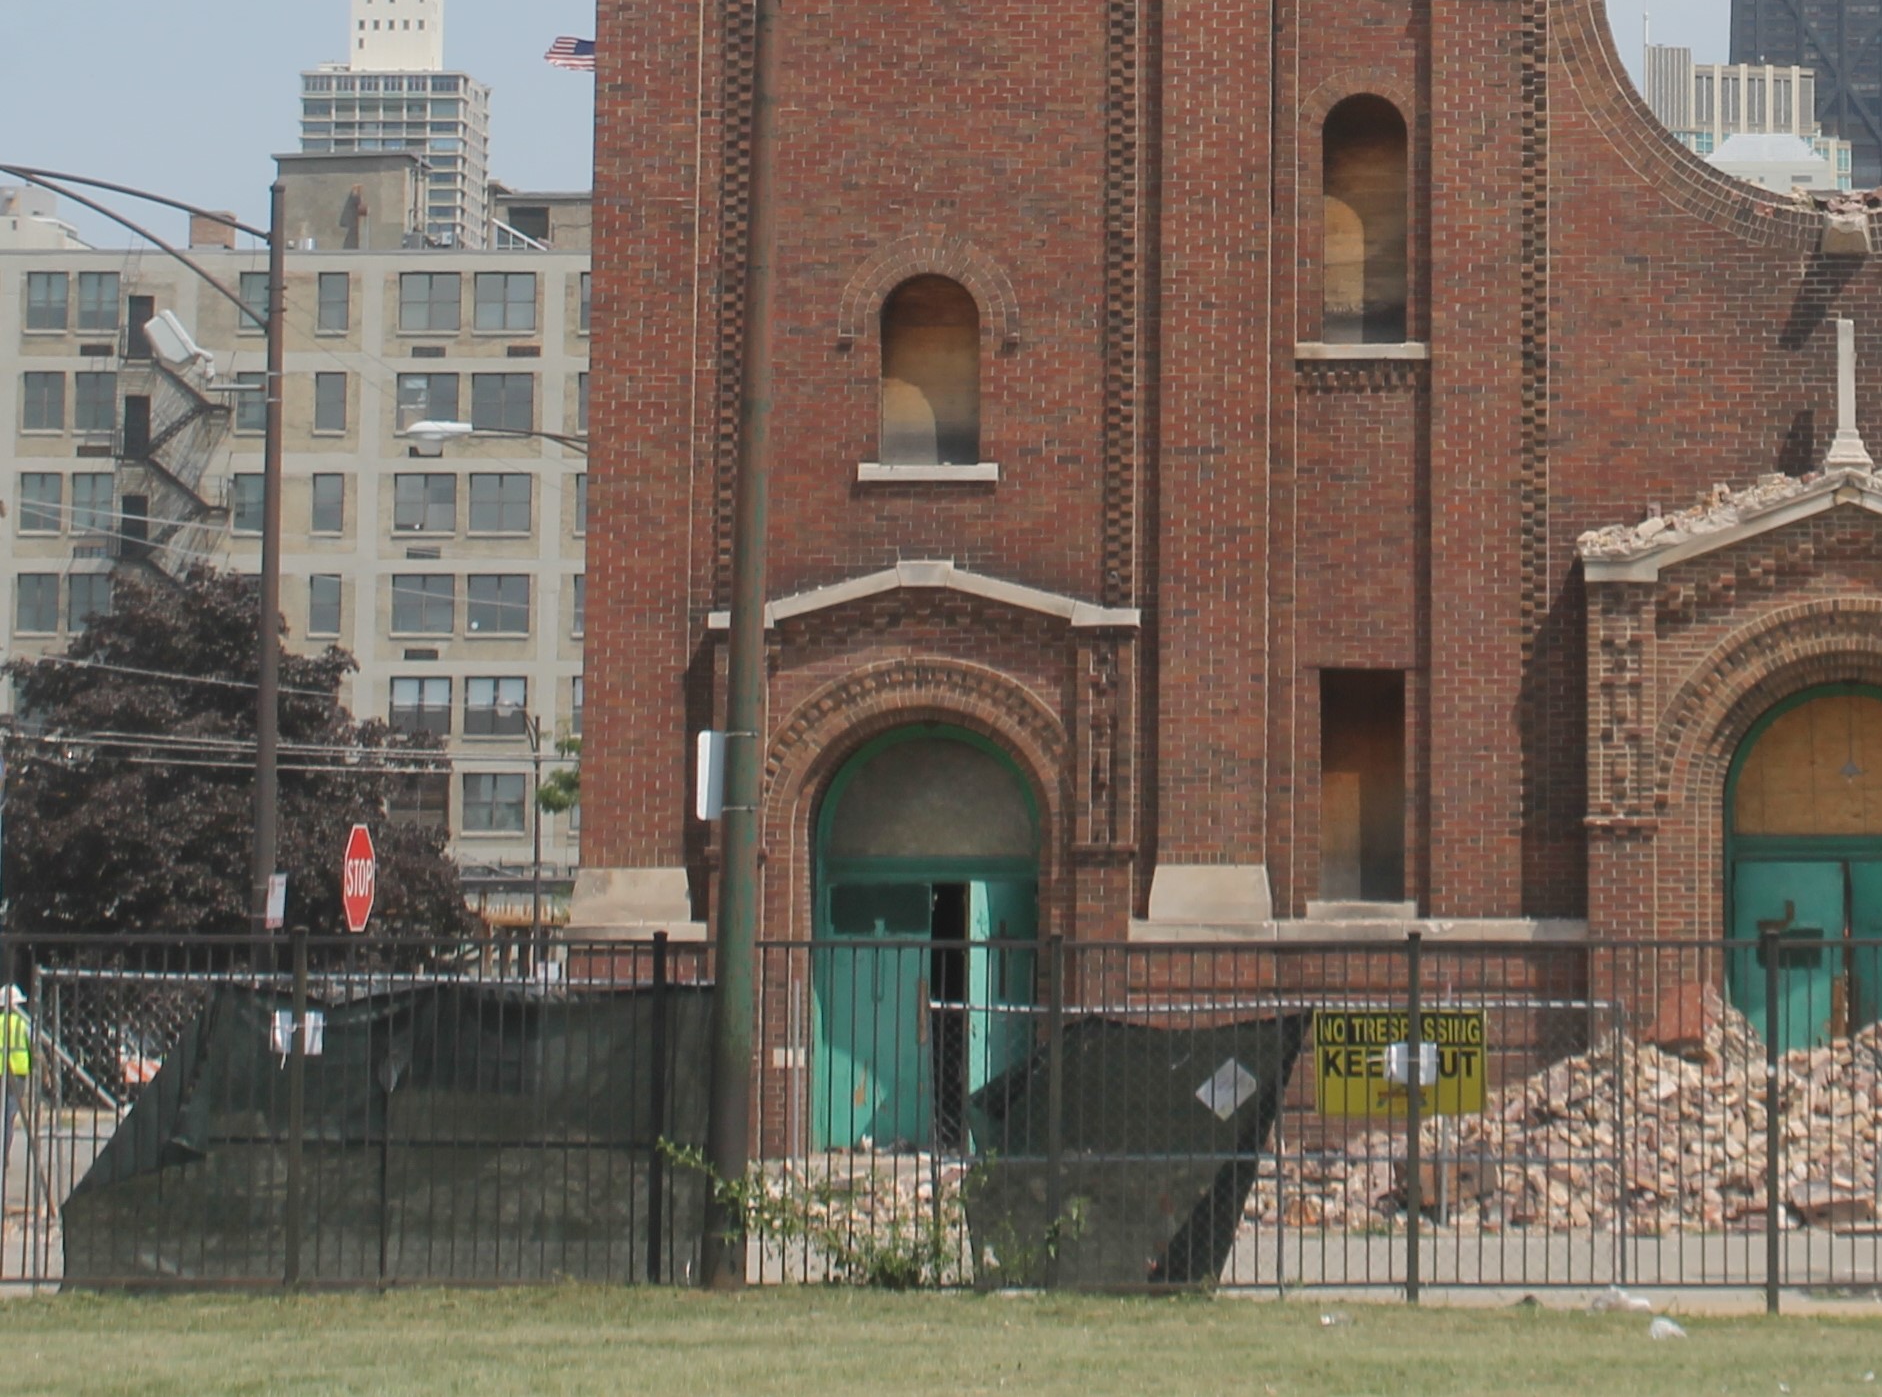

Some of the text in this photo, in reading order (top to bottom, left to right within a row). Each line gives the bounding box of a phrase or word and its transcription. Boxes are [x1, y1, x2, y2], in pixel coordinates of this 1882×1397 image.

[347, 858, 373, 897] STOP
[1320, 1017, 1480, 1043] NO TRESPSSING
[1324, 1050, 1479, 1078] KEE UT
